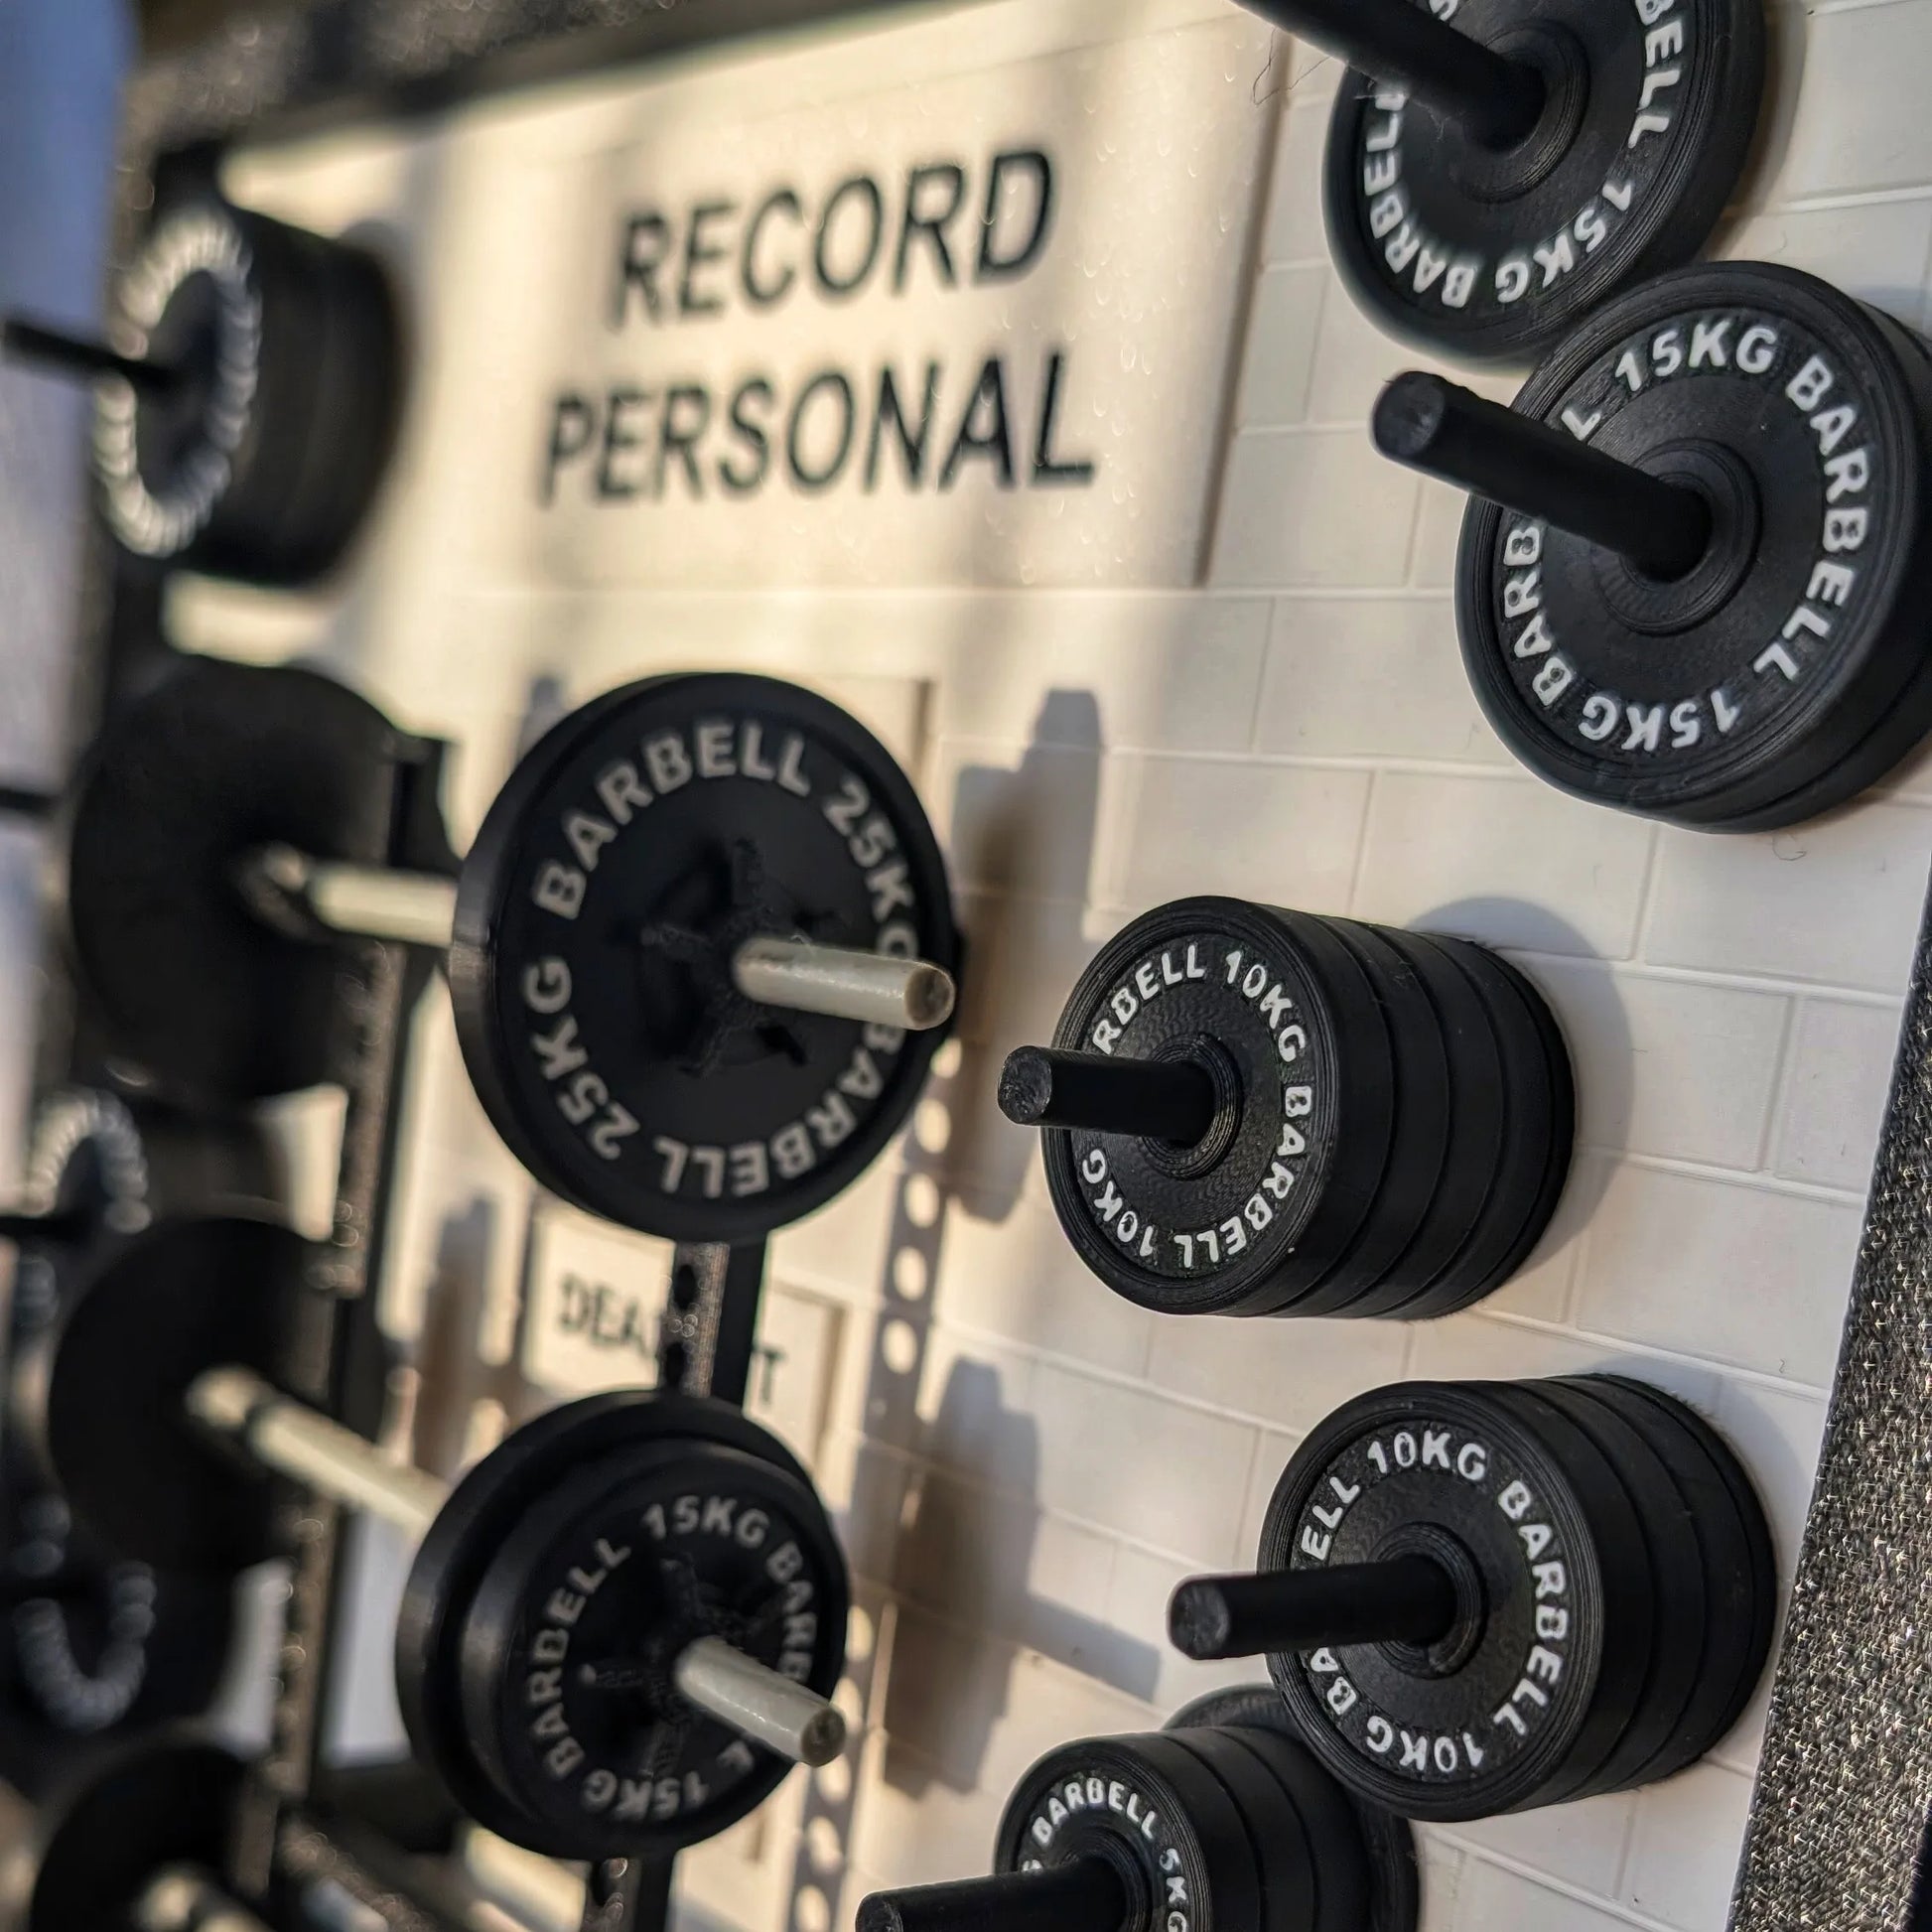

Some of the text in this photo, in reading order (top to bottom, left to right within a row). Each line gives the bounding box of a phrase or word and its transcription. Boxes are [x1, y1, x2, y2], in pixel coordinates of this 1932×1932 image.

[605, 149, 1054, 332] RECORD
[1495, 180, 1633, 303] 15KG
[1615, 321, 1777, 391] 15KG
[537, 348, 1097, 505] PERSONAL
[1754, 355, 1870, 679] BARBELL
[1579, 690, 1740, 752] 15KG
[532, 719, 811, 919] BARBELL
[522, 956, 640, 1161] 25KG
[1082, 945, 1311, 1268] RBELL 10KG BARBELL 10KG
[641, 1495, 769, 1547] 15KG
[1368, 1430, 1485, 1480] 10KG
[527, 1538, 630, 1779] BARBELL
[1494, 1480, 1568, 1735] BARBELL
[582, 1769, 708, 1819] 15KG
[1033, 1778, 1158, 1846] BARBELL
[1366, 1715, 1484, 1771] 10KG
